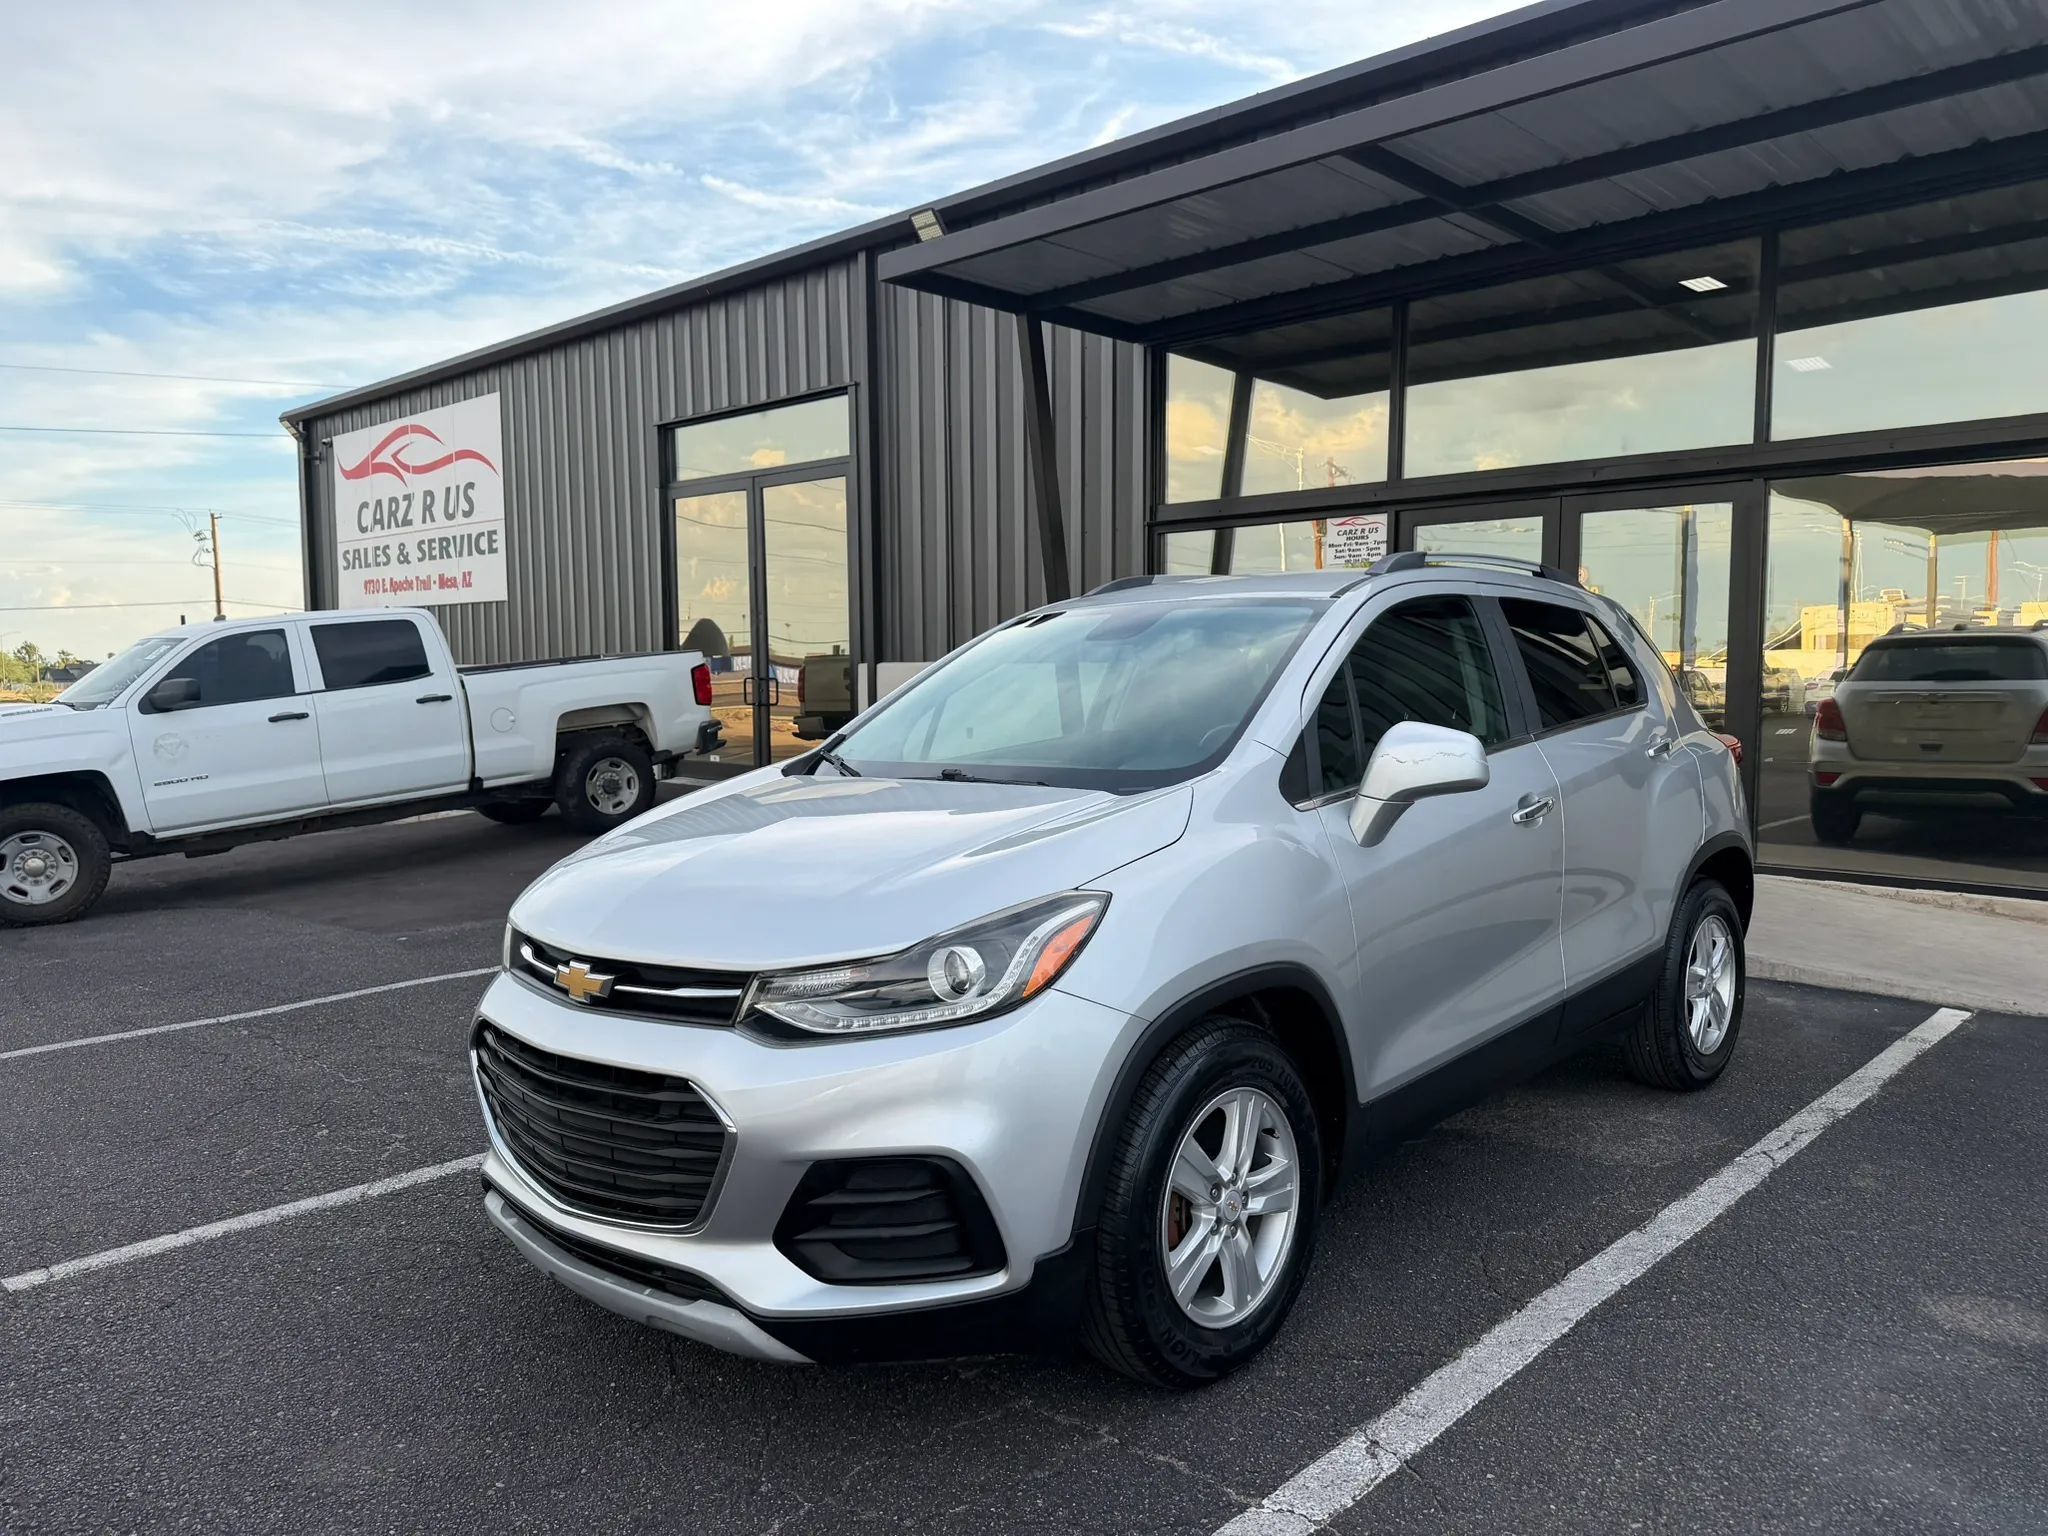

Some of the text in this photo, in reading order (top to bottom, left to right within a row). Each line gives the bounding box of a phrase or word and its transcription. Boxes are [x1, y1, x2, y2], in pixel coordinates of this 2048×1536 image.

[357, 482, 476, 534] CARZ R US
[342, 530, 498, 571] SALES & SERVICE
[415, 575, 431, 592] Trail
[462, 571, 473, 588] AZ
